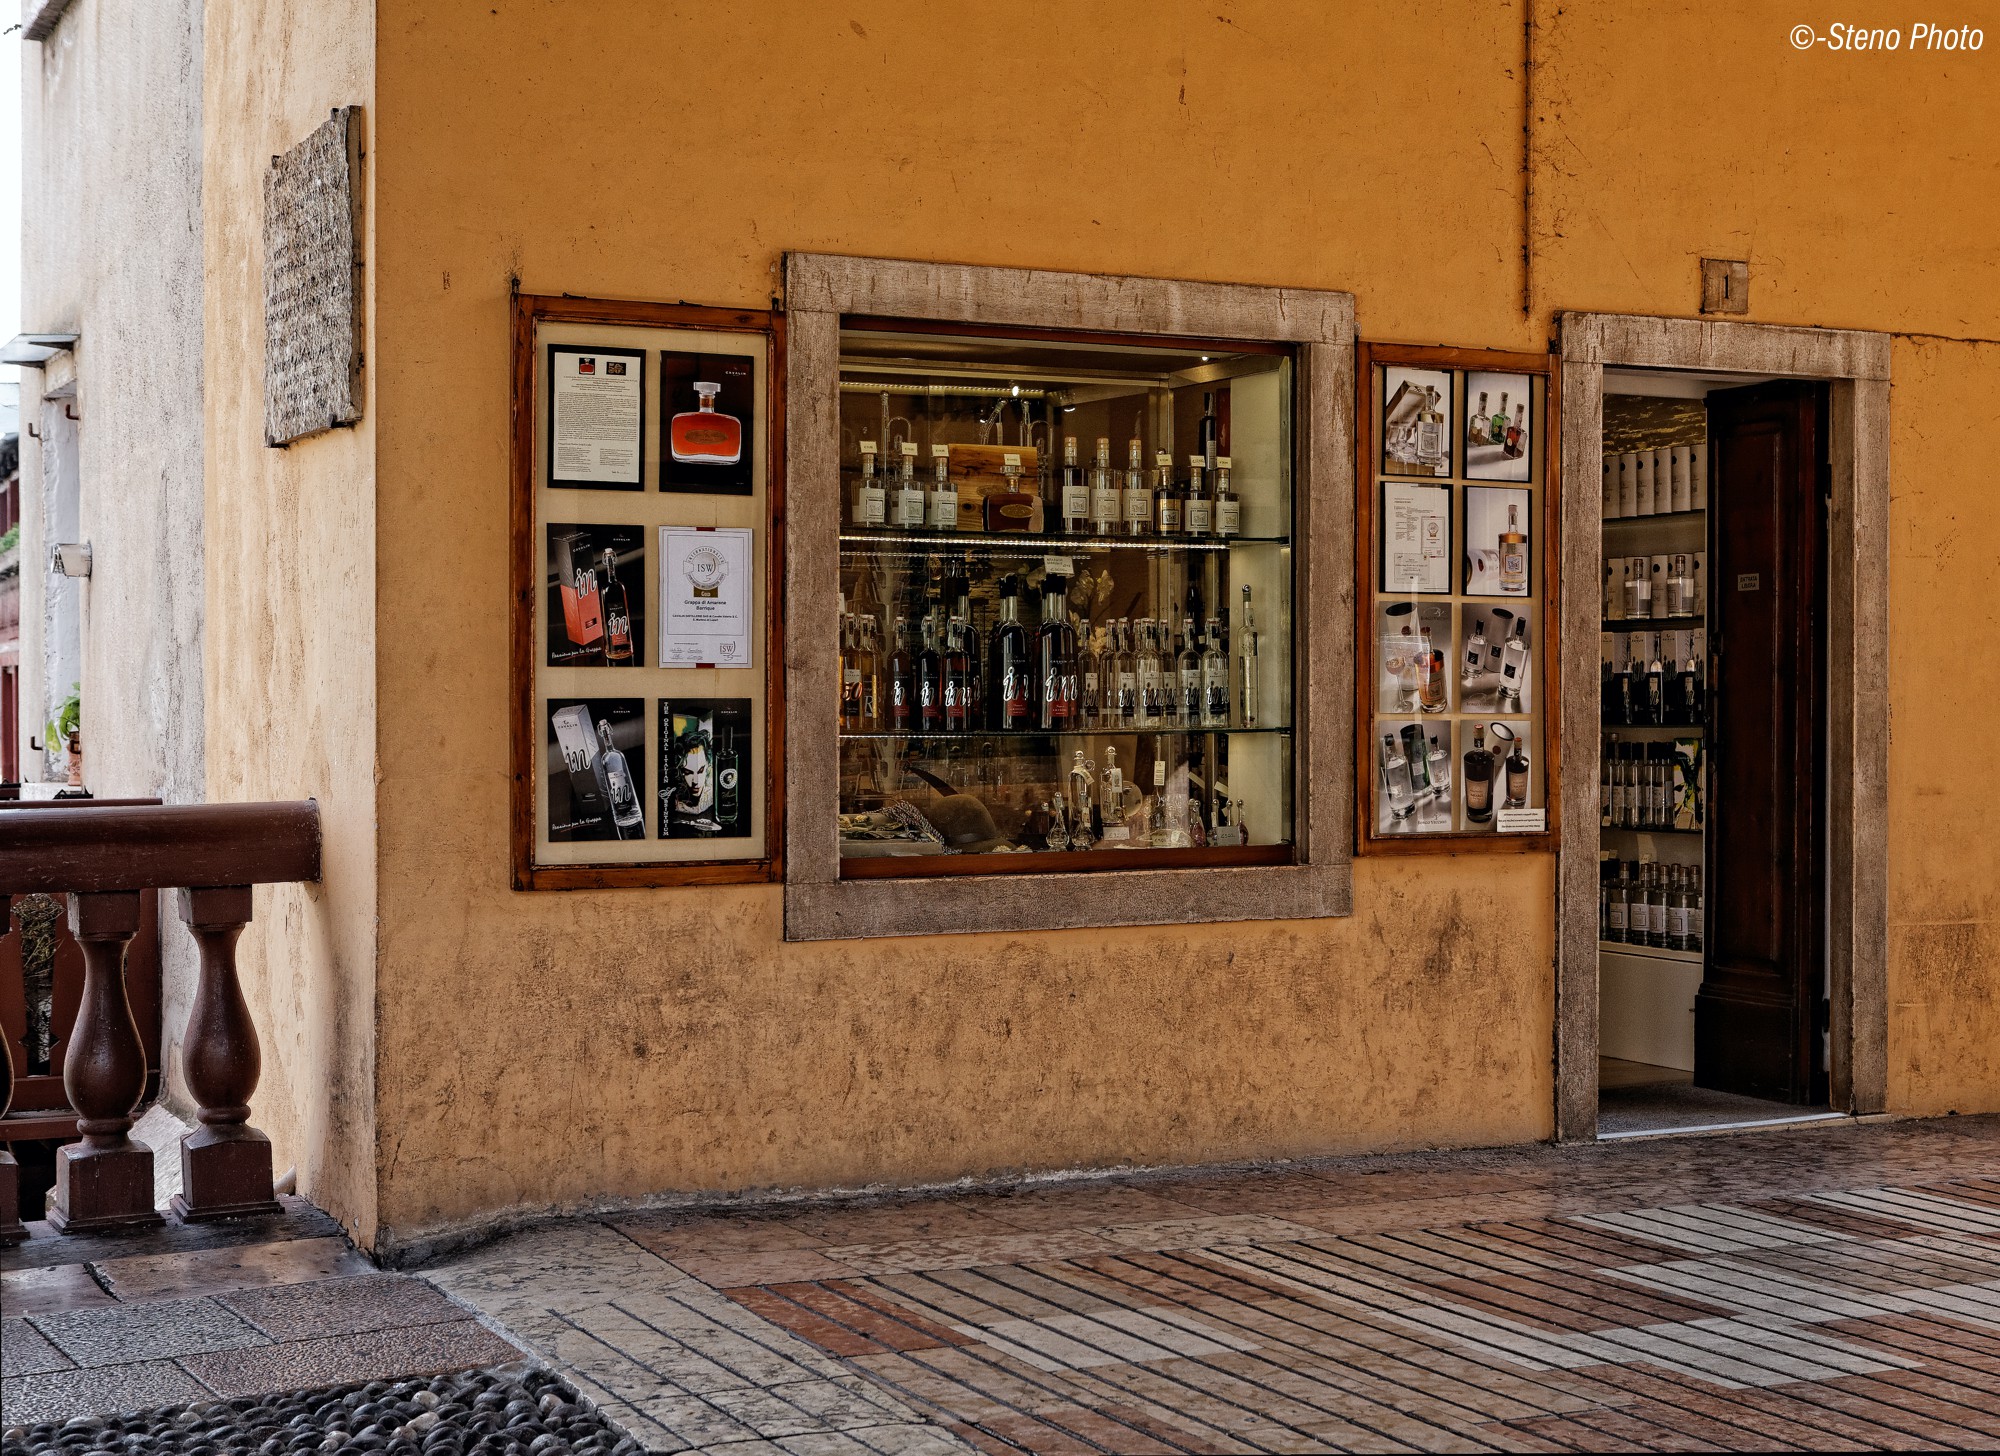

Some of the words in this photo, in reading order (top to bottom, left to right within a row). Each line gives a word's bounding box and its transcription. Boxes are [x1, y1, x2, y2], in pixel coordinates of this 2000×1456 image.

[697, 564, 714, 572] ISW
[575, 568, 598, 600] in
[608, 612, 628, 635] in
[564, 746, 591, 773] in
[611, 781, 632, 804] in
